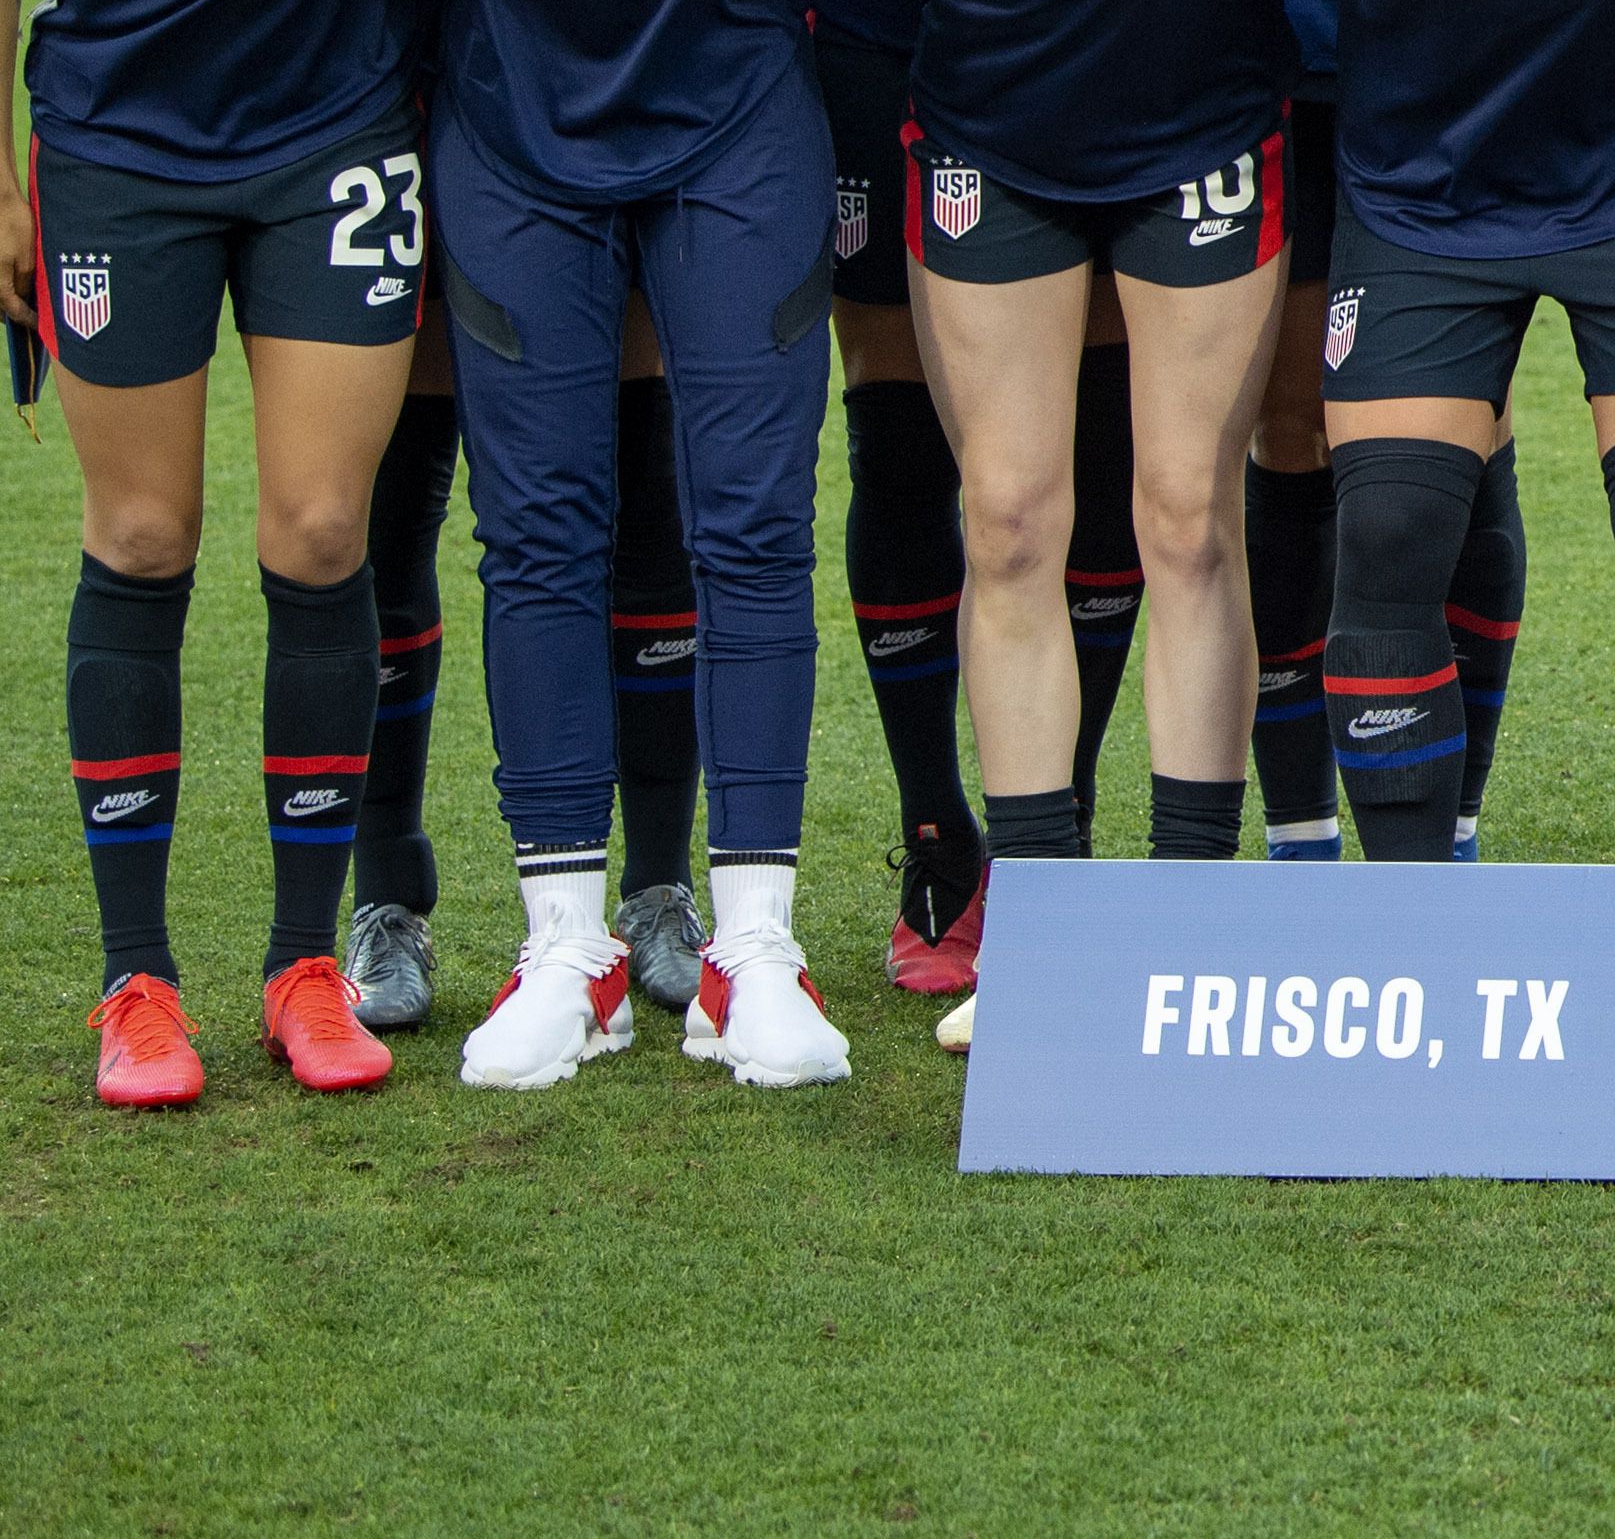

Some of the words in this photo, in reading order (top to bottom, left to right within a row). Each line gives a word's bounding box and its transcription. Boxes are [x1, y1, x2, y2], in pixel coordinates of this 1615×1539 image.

[936, 172, 979, 200] USA
[329, 152, 424, 267] 23
[838, 193, 866, 223] SA
[1198, 218, 1234, 235] NIKE
[65, 272, 107, 300] USA
[375, 276, 406, 294] NIKE
[1330, 303, 1357, 332] USA
[1141, 974, 1444, 1069] FRISCO,
[1476, 979, 1570, 1061] TX
